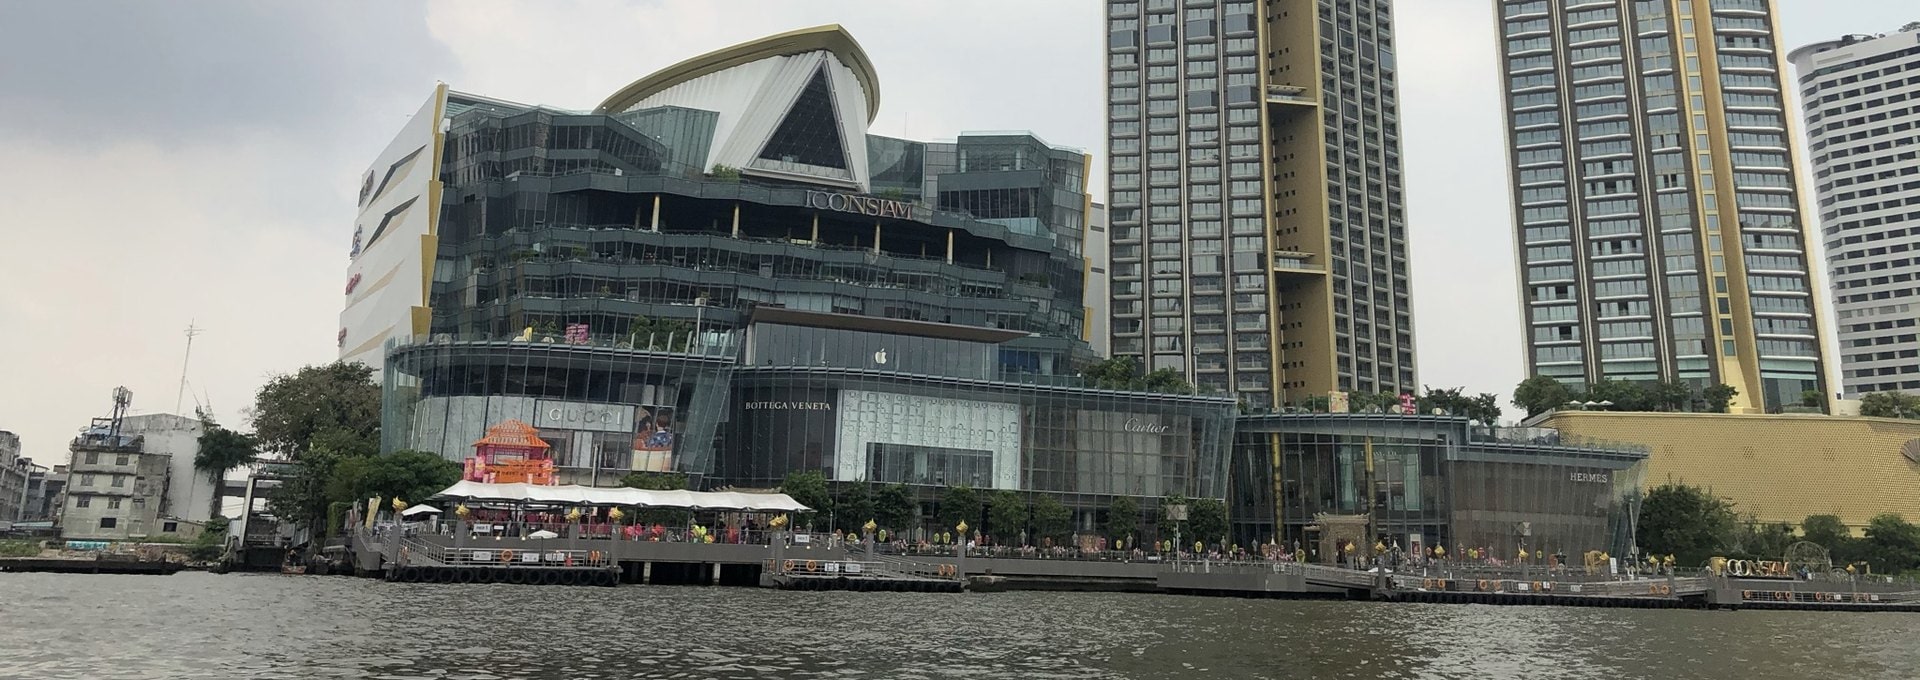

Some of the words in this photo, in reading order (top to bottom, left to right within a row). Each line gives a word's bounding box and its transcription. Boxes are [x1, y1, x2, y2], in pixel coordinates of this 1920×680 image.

[804, 189, 913, 221] ICONSIAM
[745, 401, 788, 410] BOTTEGA
[791, 401, 831, 411] VENETA
[548, 407, 621, 426] GUCCI
[1124, 417, 1169, 433] Cartier
[1722, 558, 1790, 577] CONSIAM
